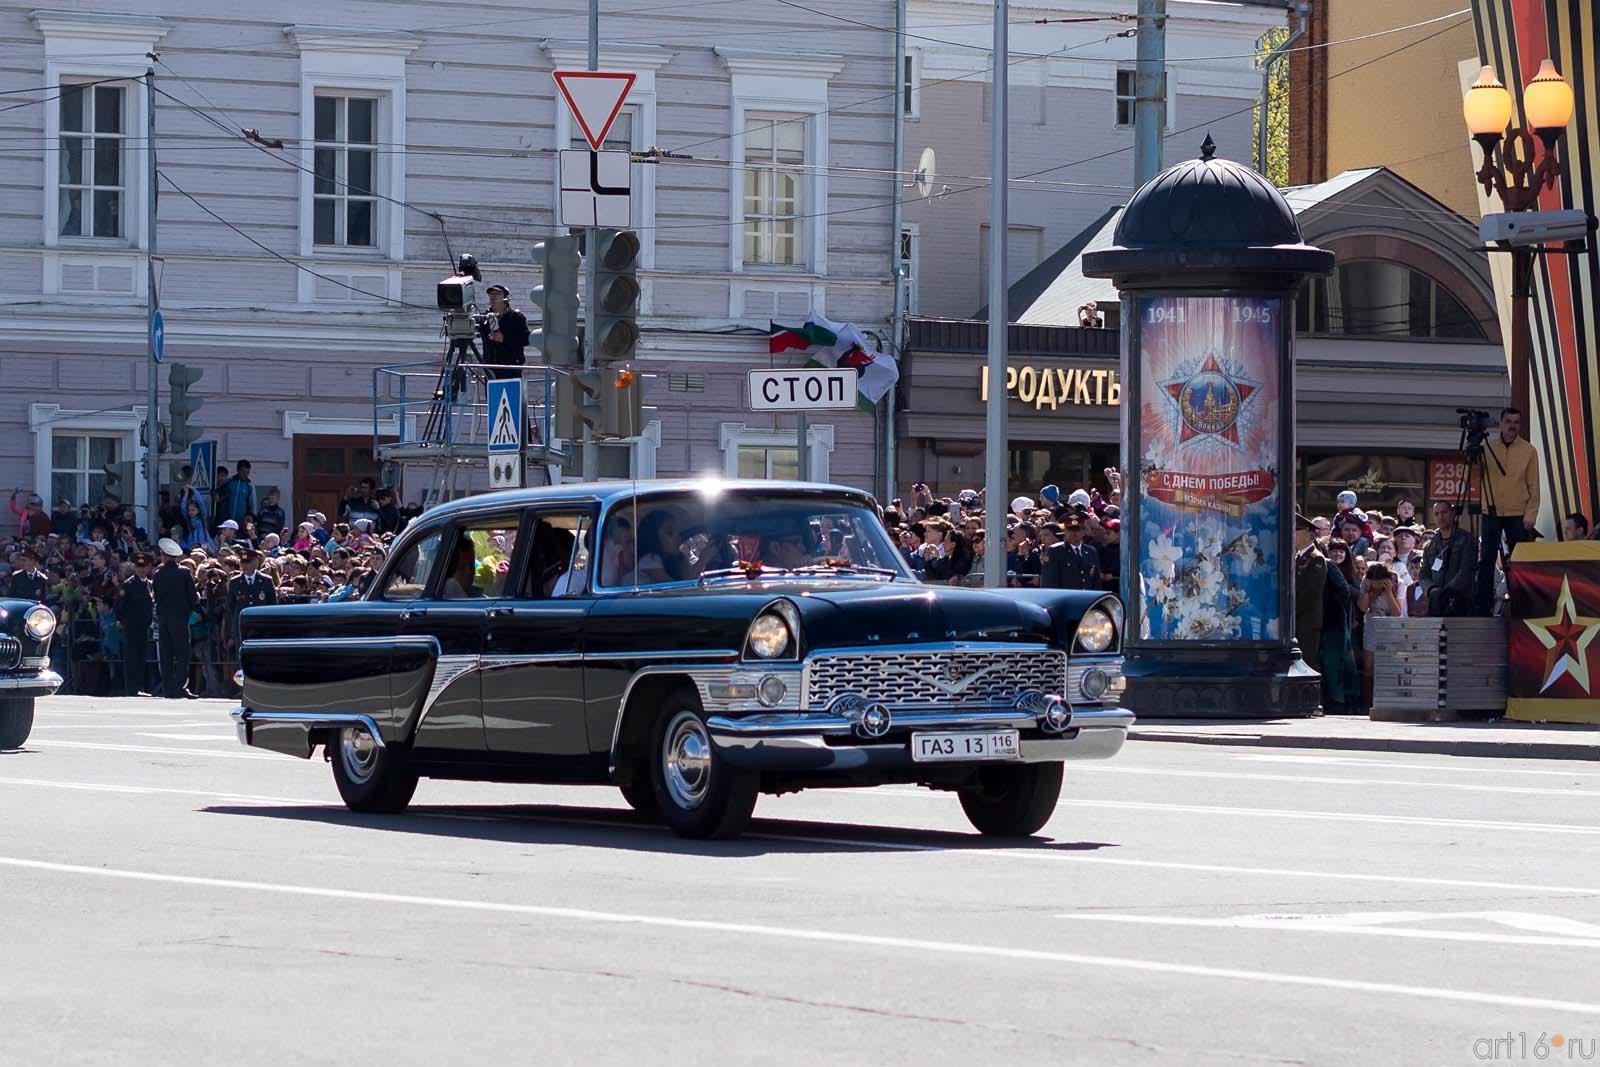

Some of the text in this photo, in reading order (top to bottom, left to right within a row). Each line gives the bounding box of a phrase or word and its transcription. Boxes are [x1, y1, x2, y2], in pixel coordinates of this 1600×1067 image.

[1148, 306, 1185, 323] 1941
[1233, 306, 1270, 324] 1945
[762, 376, 844, 403] СТОП
[1435, 463, 1465, 478] 238
[1171, 475, 1206, 490] ДНЕМ
[1209, 474, 1260, 490] ПОБЕДЫ!
[922, 735, 1012, 755] ГАЗ 13 116
